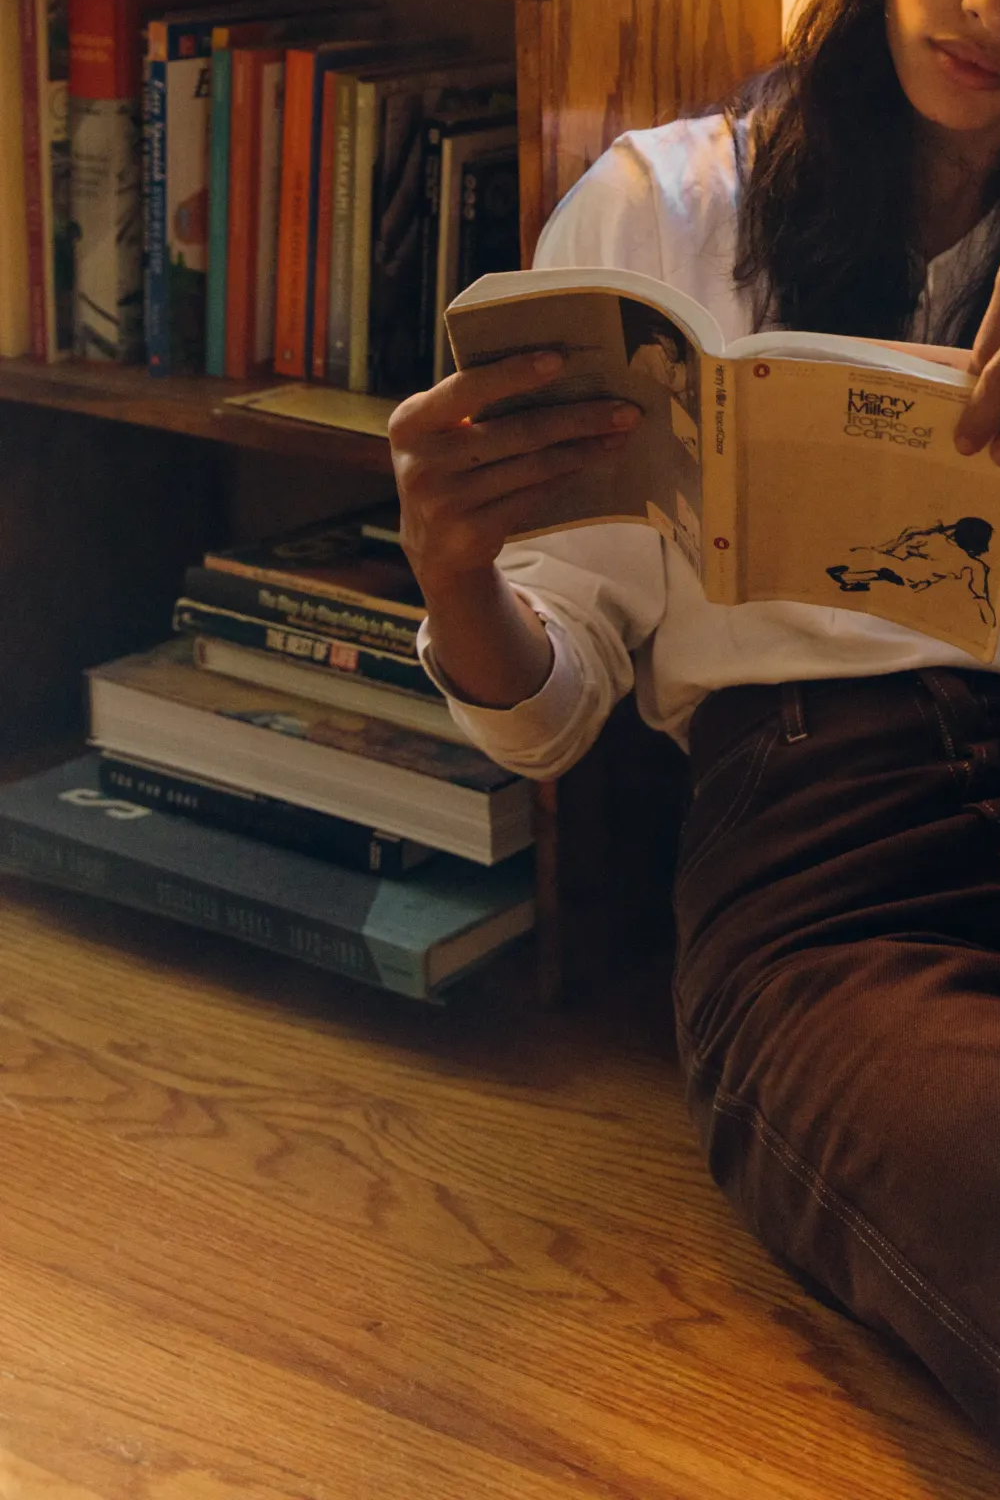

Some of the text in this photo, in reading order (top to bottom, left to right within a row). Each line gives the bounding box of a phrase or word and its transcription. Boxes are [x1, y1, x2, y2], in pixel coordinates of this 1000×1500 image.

[713, 364, 726, 386] Henry
[716, 388, 727, 407] Miller
[848, 388, 916, 412] Henry
[848, 399, 904, 420] Miller
[843, 424, 932, 449] Cancer
[844, 411, 935, 438] Tropic of
[266, 627, 285, 651] THE
[313, 640, 328, 661] OF
